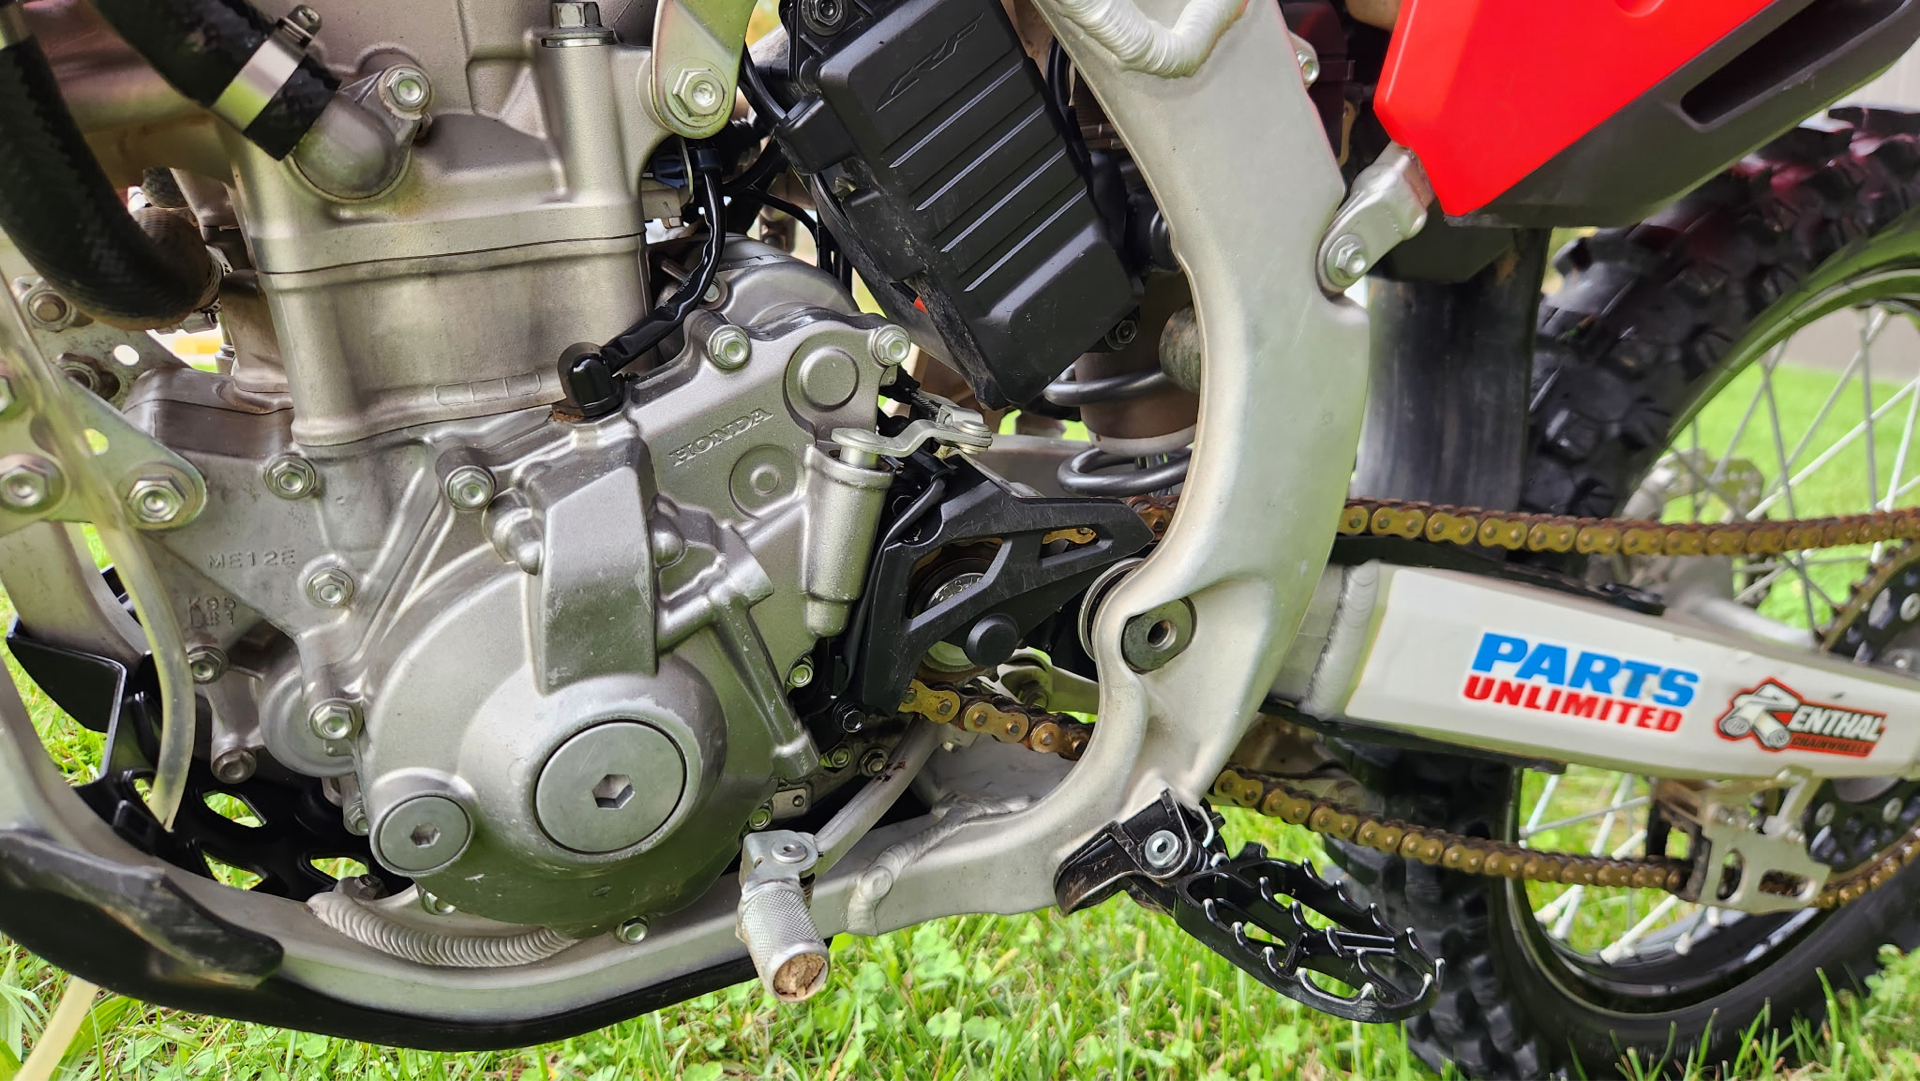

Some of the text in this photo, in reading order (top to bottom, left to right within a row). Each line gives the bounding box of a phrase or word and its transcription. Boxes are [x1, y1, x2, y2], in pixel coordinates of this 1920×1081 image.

[668, 408, 774, 467] HONDA
[207, 550, 295, 569] ME12E
[1471, 632, 1699, 707] PARTS
[1463, 674, 1683, 732] UNLIMITED
